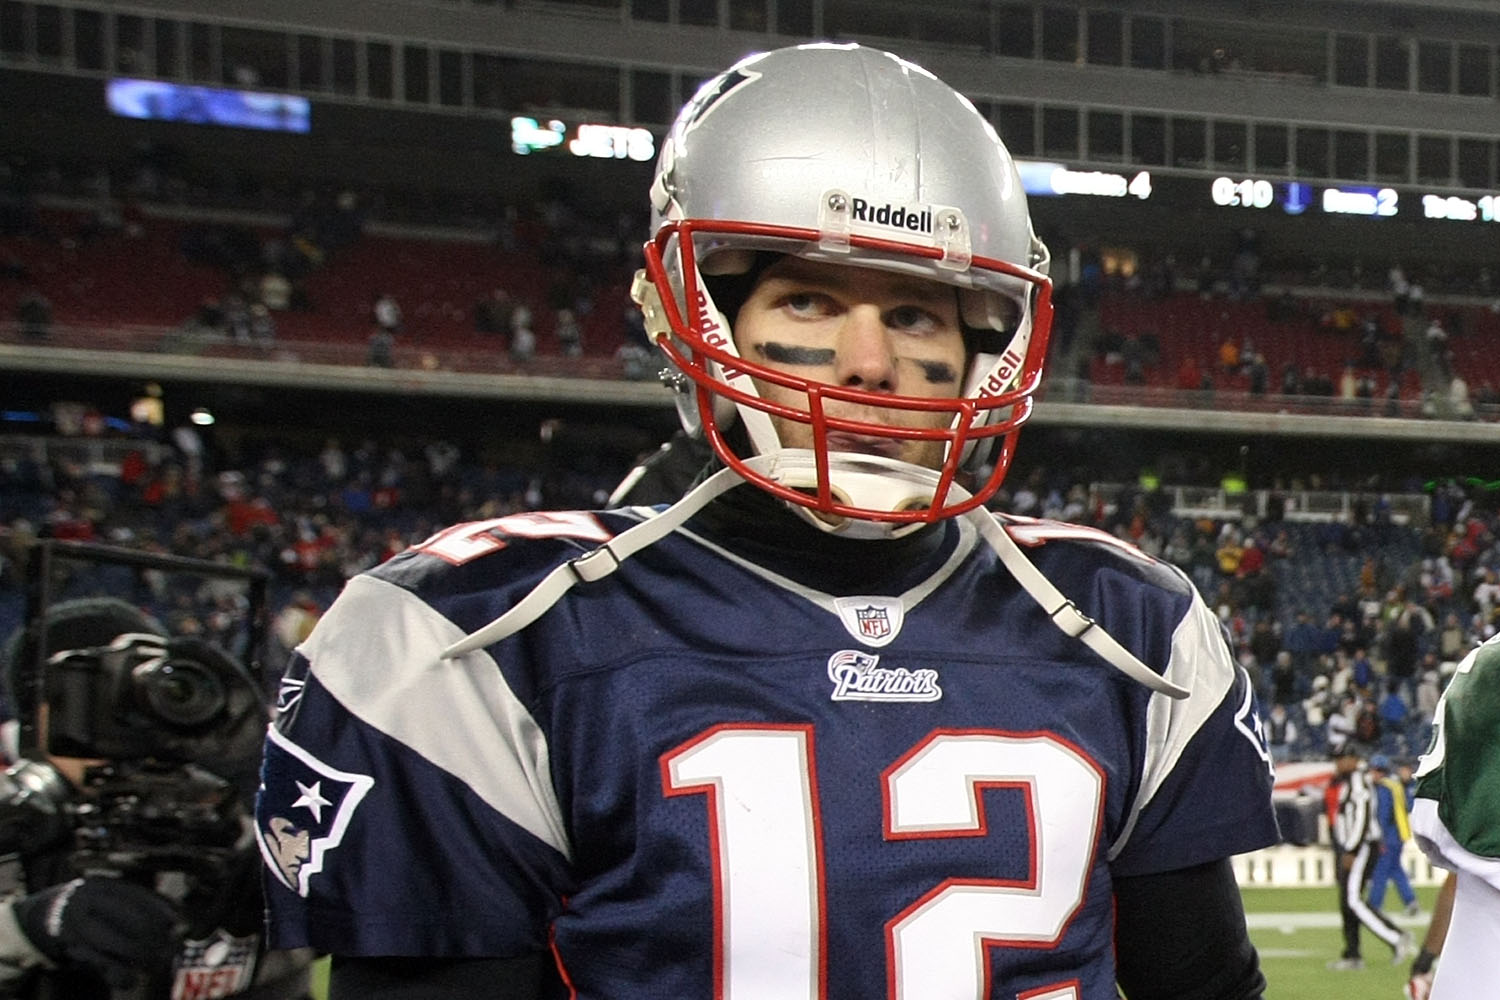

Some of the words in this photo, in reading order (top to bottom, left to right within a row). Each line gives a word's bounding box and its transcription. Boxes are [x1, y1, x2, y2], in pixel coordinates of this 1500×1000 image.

[569, 124, 655, 162] JETS
[852, 198, 931, 234] Riddell
[861, 619, 890, 636] NFL
[830, 662, 942, 701] Patriots
